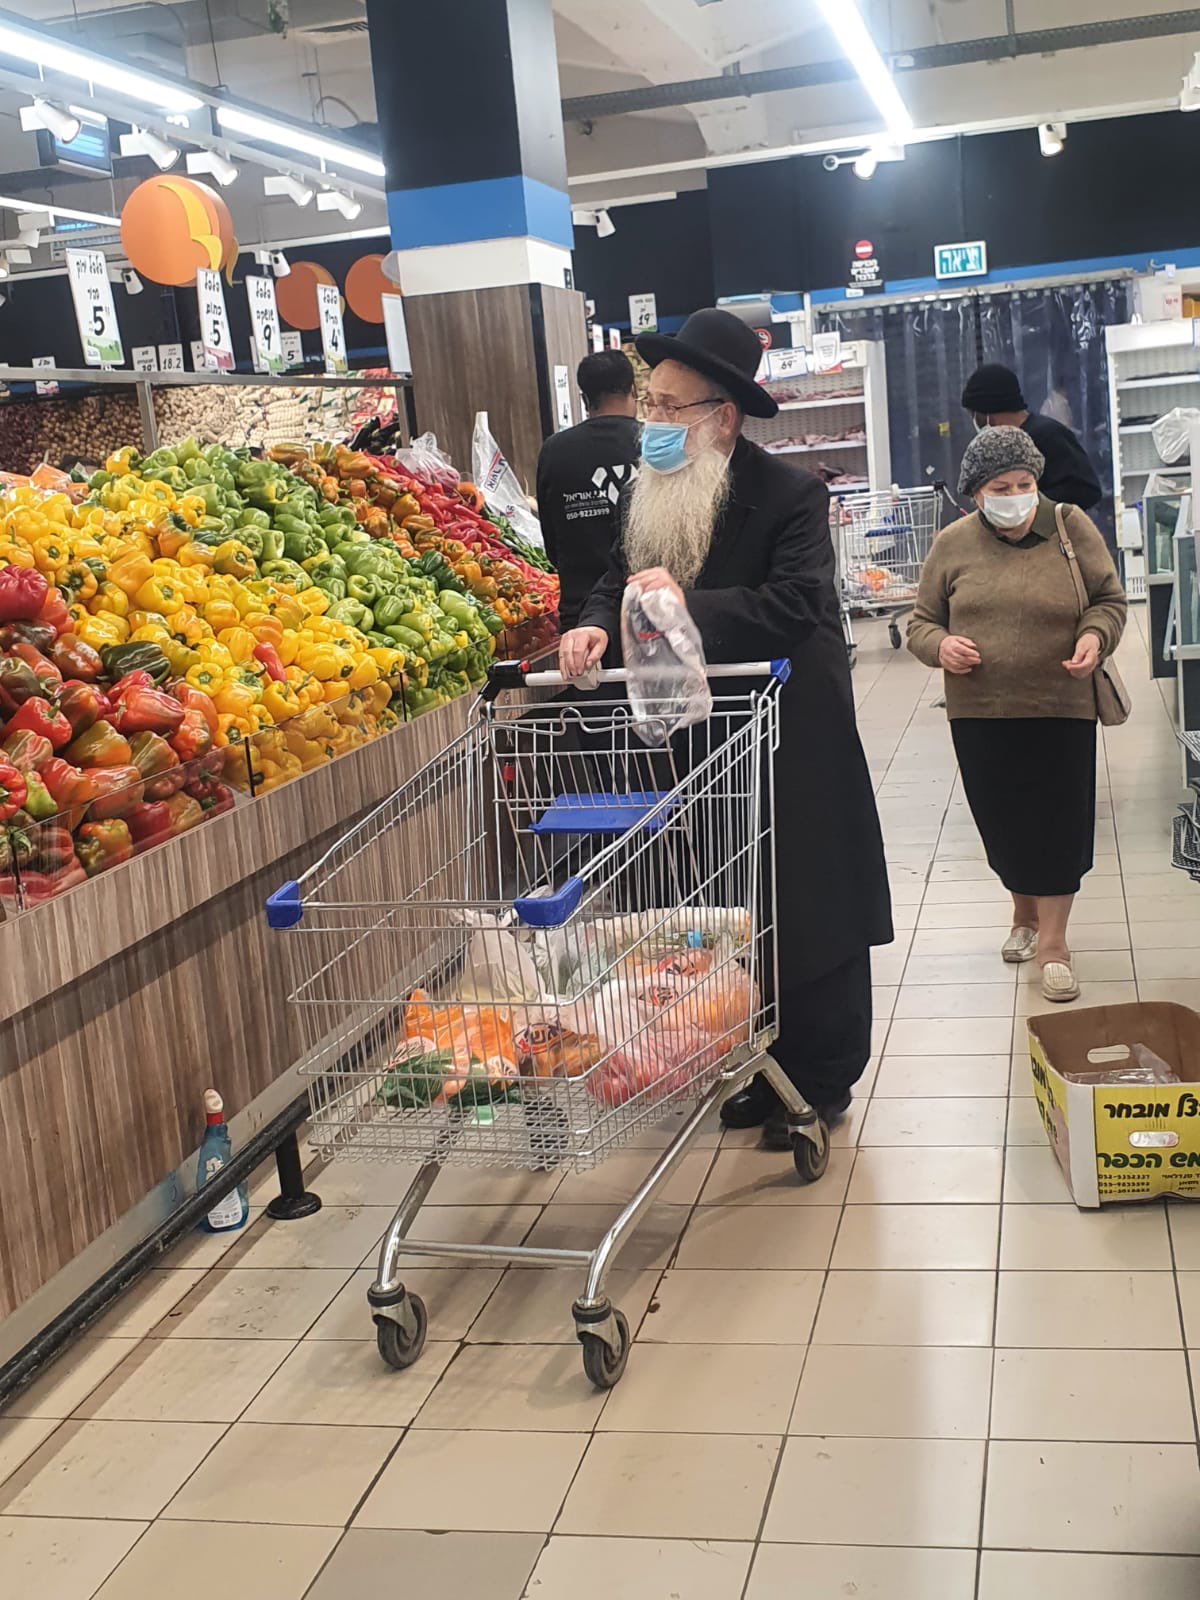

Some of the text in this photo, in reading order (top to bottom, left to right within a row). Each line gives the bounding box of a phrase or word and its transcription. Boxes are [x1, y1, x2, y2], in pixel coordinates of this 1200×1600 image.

[941, 247, 980, 273] יציאה
[93, 306, 105, 336] 5
[639, 313, 650, 326] 19
[212, 320, 221, 346] 5
[263, 324, 272, 351] 9
[331, 328, 339, 352] 4
[1103, 1093, 1200, 1118] צל מובחר
[1097, 1152, 1162, 1168] הכפר
